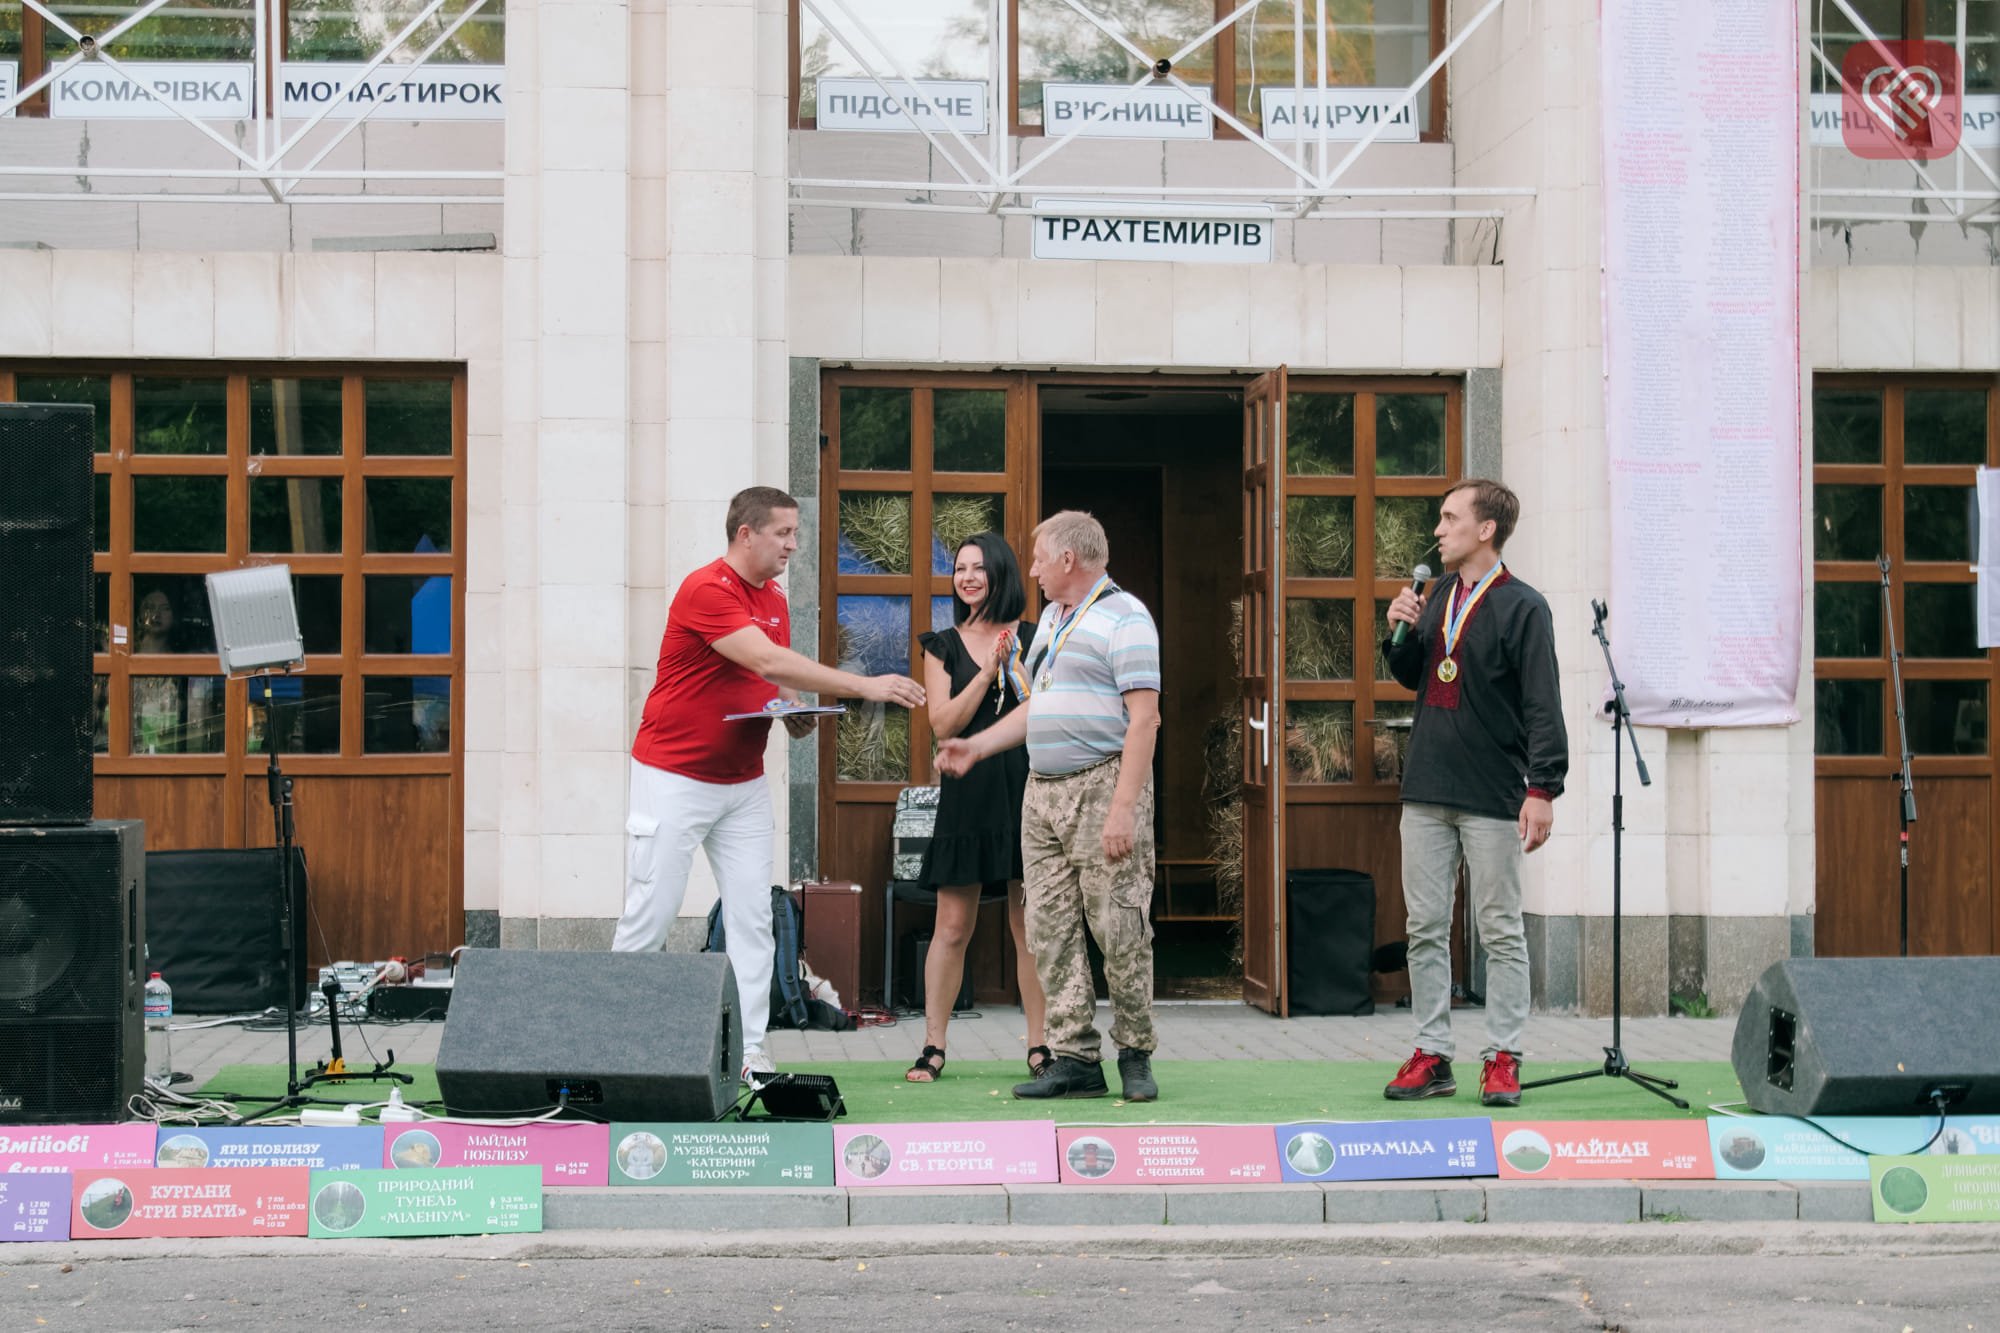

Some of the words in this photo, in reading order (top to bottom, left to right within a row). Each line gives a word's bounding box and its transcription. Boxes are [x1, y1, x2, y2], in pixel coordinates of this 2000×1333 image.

[60, 80, 242, 102] КОМАРІВКА
[1041, 217, 1262, 247] ТРАХТЕМИРІВ
[0, 1135, 90, 1154] Змійові
[467, 1134, 527, 1148] МАЙДАН
[672, 1132, 770, 1144] МЕМОРІАЛЬНИЙ
[1138, 1136, 1197, 1145] ОСВЯЧЕНА
[219, 1144, 248, 1155] ЯРИ
[252, 1143, 322, 1155] ПОБЛИЗУ
[673, 1145, 768, 1157] МУЗЕЙ-САДИБА
[905, 1140, 986, 1155] ДЖЕРЕЛО
[1138, 1146, 1200, 1155] КРИНИЧКА
[1339, 1140, 1436, 1157] ПІРАМІДА
[1555, 1138, 1650, 1158] МАЙДАН
[463, 1149, 529, 1161] ПОБЛИЗУ
[1143, 1156, 1196, 1166] ПОБЛИЗУ
[212, 1157, 267, 1168] ХУТОРУ
[270, 1157, 325, 1168] ВЕСЕЛЕ
[686, 1157, 756, 1168] «КАТЕРИНИ
[899, 1160, 924, 1172] СВ.
[927, 1157, 994, 1172] ГЕОРГІЯ
[691, 1169, 750, 1180] БІЛОКУР»
[1148, 1167, 1205, 1177] ЧОПИЛКИ
[378, 1176, 474, 1193] ПРИРОДНИЙ
[150, 1184, 232, 1199] КУРГАНИ
[395, 1195, 457, 1208] ТУНЕЛЬ
[133, 1205, 177, 1219] «ТРИ
[181, 1203, 247, 1219] БРАТИ»
[380, 1209, 472, 1224] «МІЛЕНІУМ»
